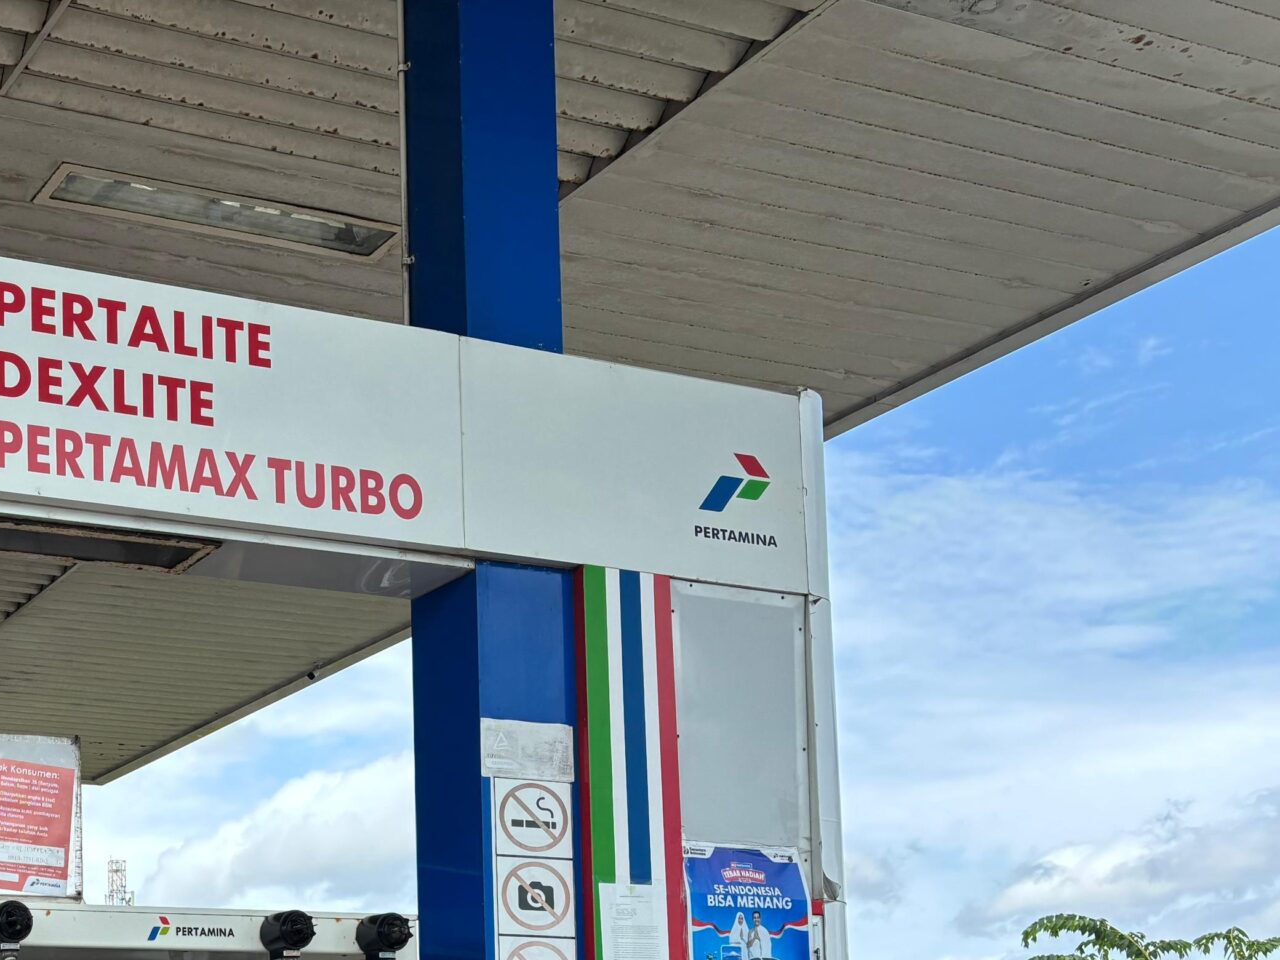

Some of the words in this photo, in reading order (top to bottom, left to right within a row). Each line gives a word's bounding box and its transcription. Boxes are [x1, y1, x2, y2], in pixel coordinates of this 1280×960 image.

[267, 456, 424, 521] TURBO
[694, 525, 778, 548] PERTAMINA
[11, 765, 60, 779] Konsumen:
[713, 884, 782, 897] SE-INDONESIA
[707, 895, 735, 907] BISA
[736, 896, 793, 910] MENANG
[175, 926, 235, 937] PERTAMINA
